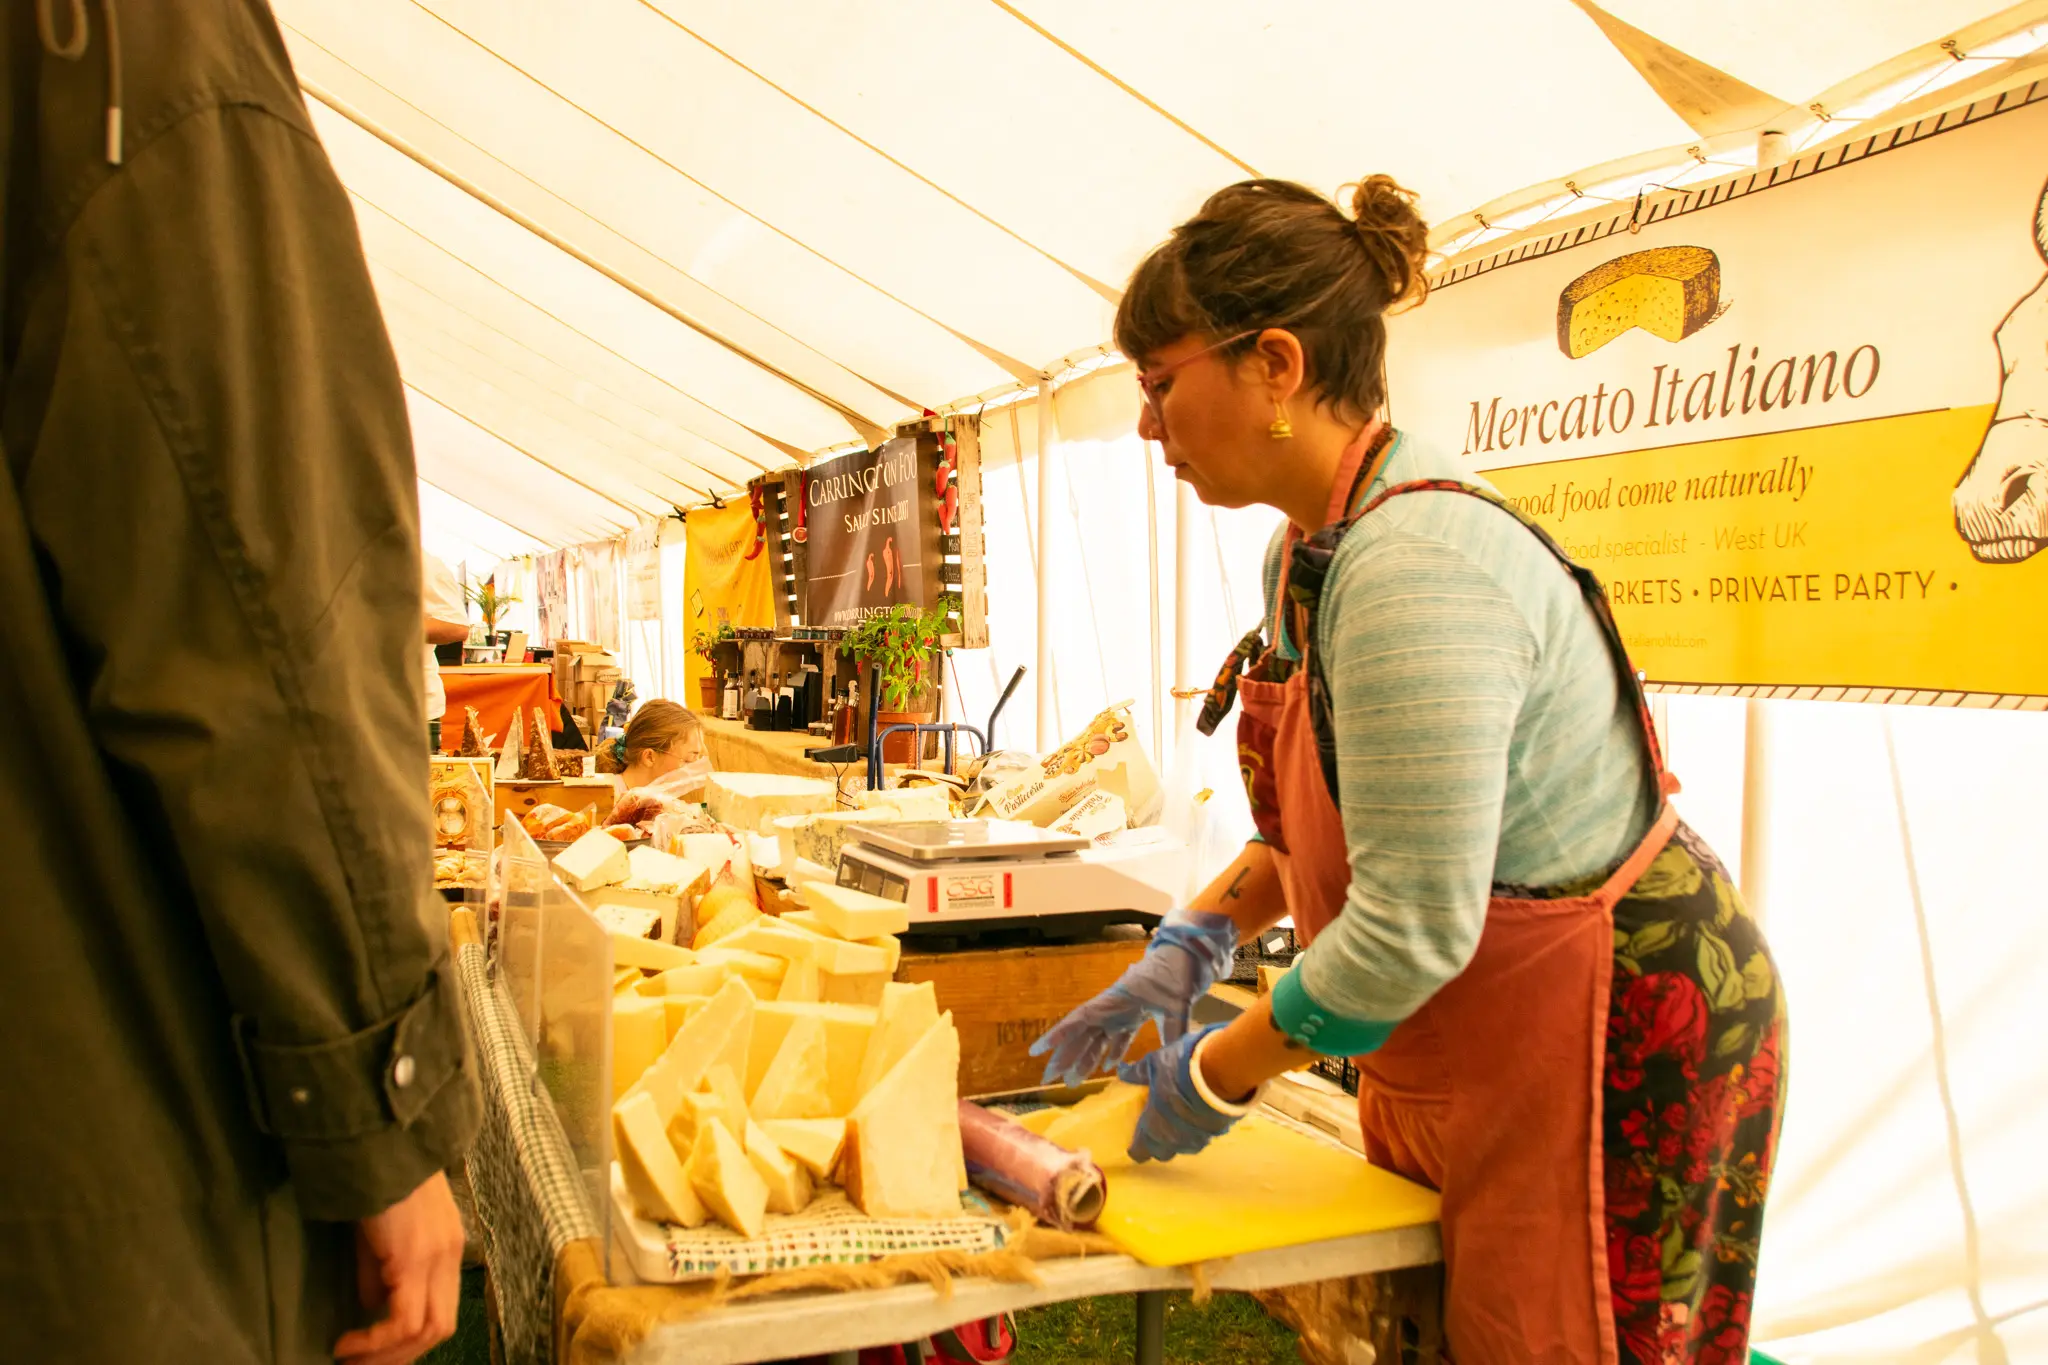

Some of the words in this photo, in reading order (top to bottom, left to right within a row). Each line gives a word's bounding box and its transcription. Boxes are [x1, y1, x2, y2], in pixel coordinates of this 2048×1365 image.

[1462, 383, 1635, 455] Mercato
[1644, 344, 1881, 428] Italiano
[1558, 478, 1613, 522] food
[1618, 479, 1677, 508] come
[1684, 455, 1814, 502] naturally
[1563, 535, 1602, 560] food
[1604, 529, 1687, 563] specialist
[1714, 525, 1766, 551] West
[1774, 521, 1808, 548] UK
[1710, 574, 1822, 603] PRIVATE
[1835, 570, 1935, 601] PARTY
[1003, 780, 1045, 814] Pasticceria
[947, 879, 994, 897] CSG
